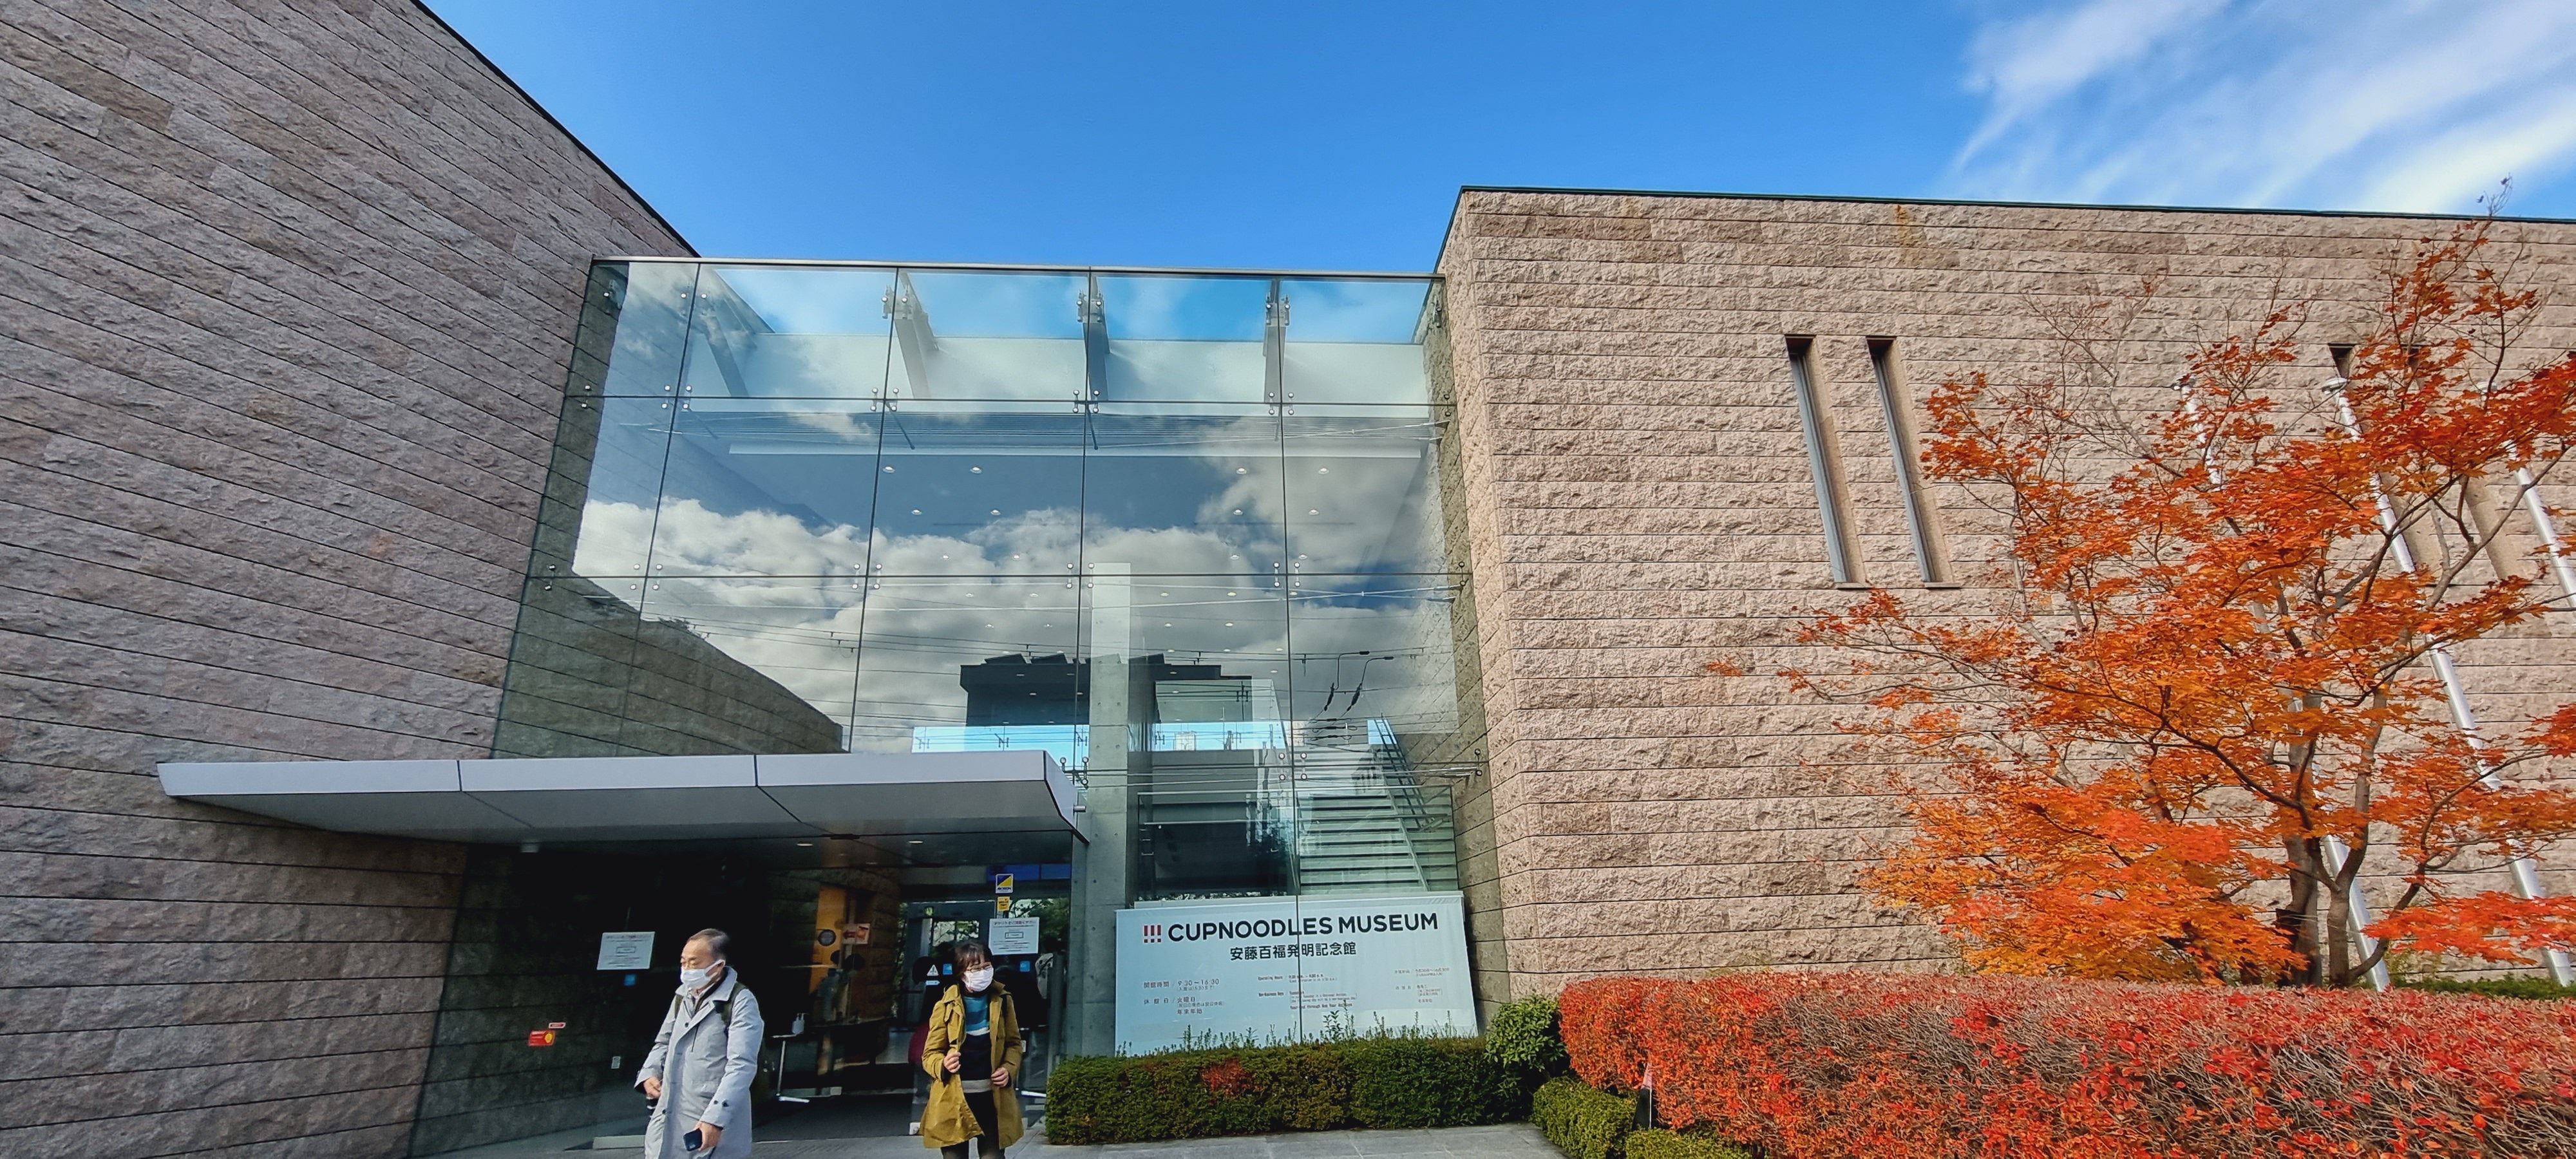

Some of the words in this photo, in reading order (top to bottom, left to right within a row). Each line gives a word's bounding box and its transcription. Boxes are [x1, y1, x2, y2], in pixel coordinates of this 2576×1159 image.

[1168, 917, 1333, 941] CUPNOODLES
[1338, 913, 1438, 934] MUSEUM
[1230, 941, 1356, 961] 安藤百福発明記念館
